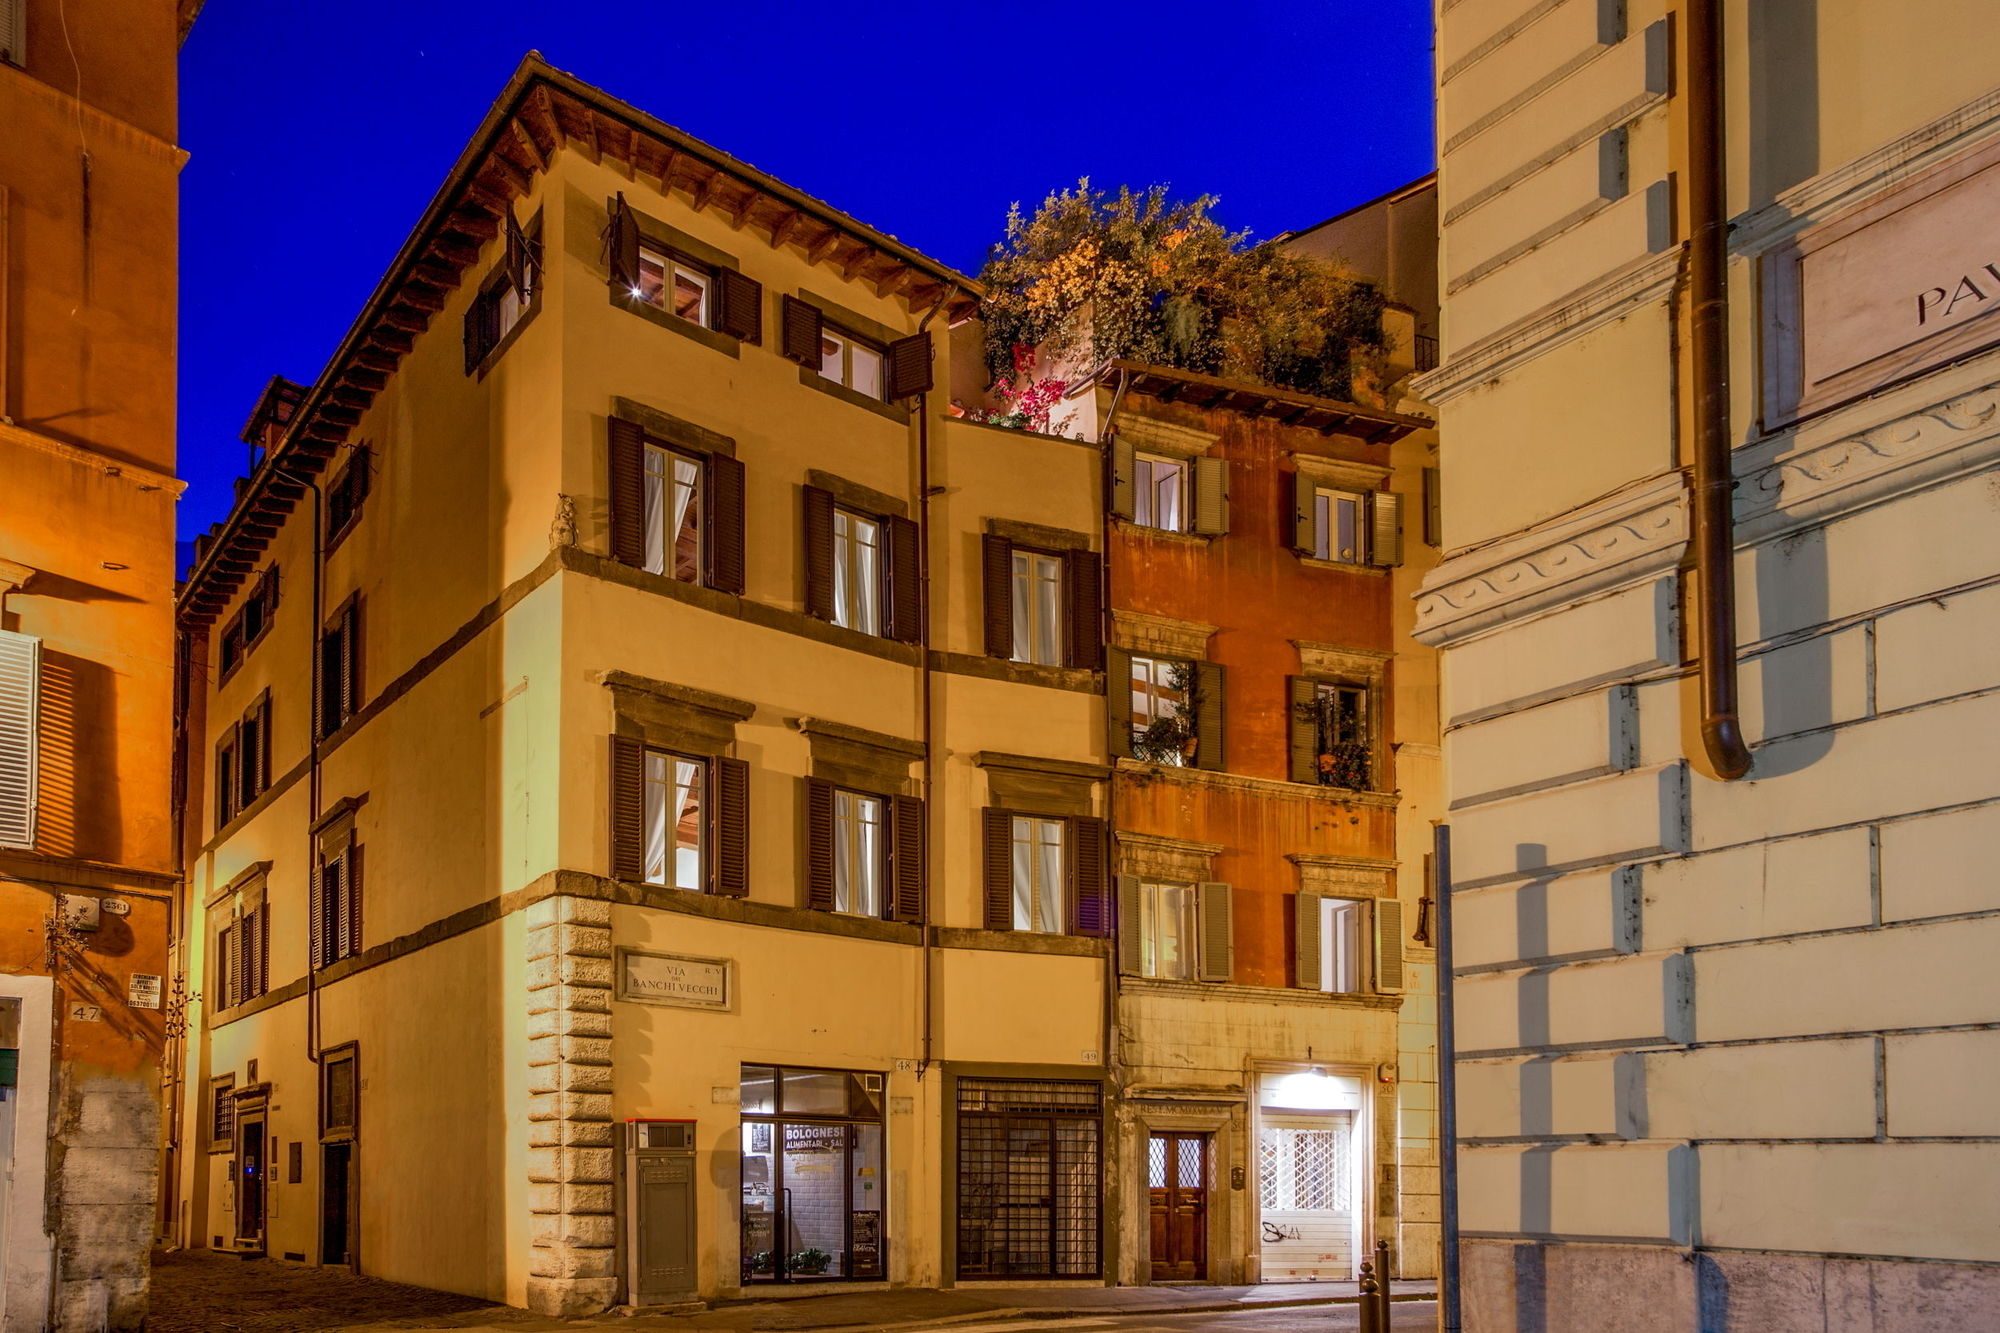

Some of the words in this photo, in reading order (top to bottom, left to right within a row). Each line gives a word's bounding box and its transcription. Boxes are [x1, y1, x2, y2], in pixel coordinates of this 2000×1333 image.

[666, 966, 686, 976] VIA
[633, 978, 676, 992] BANCHI
[679, 983, 718, 995] VECCHI
[73, 1007, 99, 1020] 47
[1083, 1052, 1096, 1061] 49
[897, 1060, 911, 1071] 48
[786, 1140, 823, 1150] ALIMENTARI
